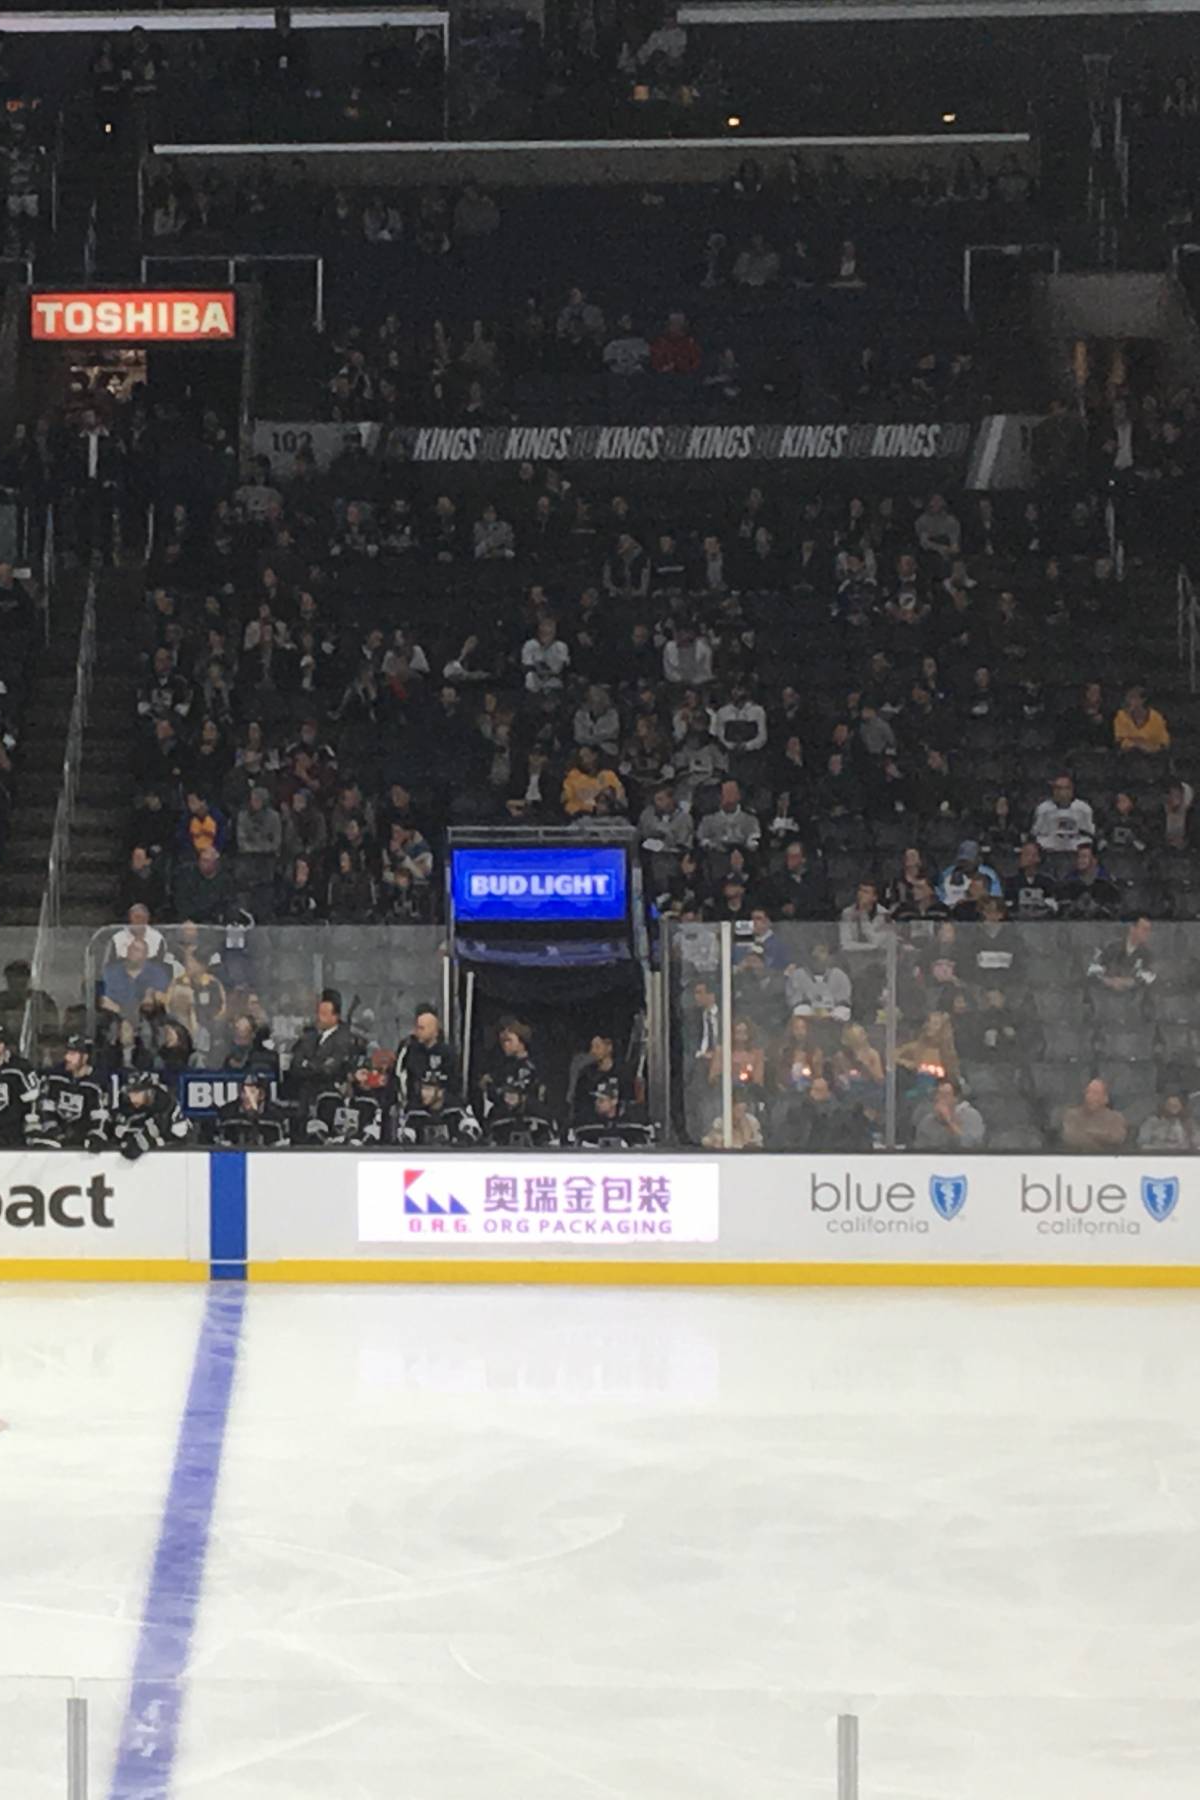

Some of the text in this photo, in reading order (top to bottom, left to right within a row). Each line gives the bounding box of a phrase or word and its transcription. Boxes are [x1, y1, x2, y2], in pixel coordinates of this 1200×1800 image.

[36, 301, 230, 334] TOSHIBA
[412, 427, 480, 461] KINGS
[504, 427, 572, 460] KINGS
[596, 426, 664, 459] KINGS
[686, 425, 755, 459] KINGS
[779, 425, 848, 458] KINGS
[871, 423, 941, 457] KINGS
[471, 874, 610, 896] BUD LIGHT
[187, 1081, 239, 1108] BU
[484, 1174, 672, 1213] 奥瑞金包装
[811, 1172, 915, 1213] blue
[1020, 1173, 1127, 1214] blue
[483, 1218, 672, 1234] ORG PACKAGING
[826, 1216, 930, 1234] california
[1036, 1217, 1141, 1235] california
